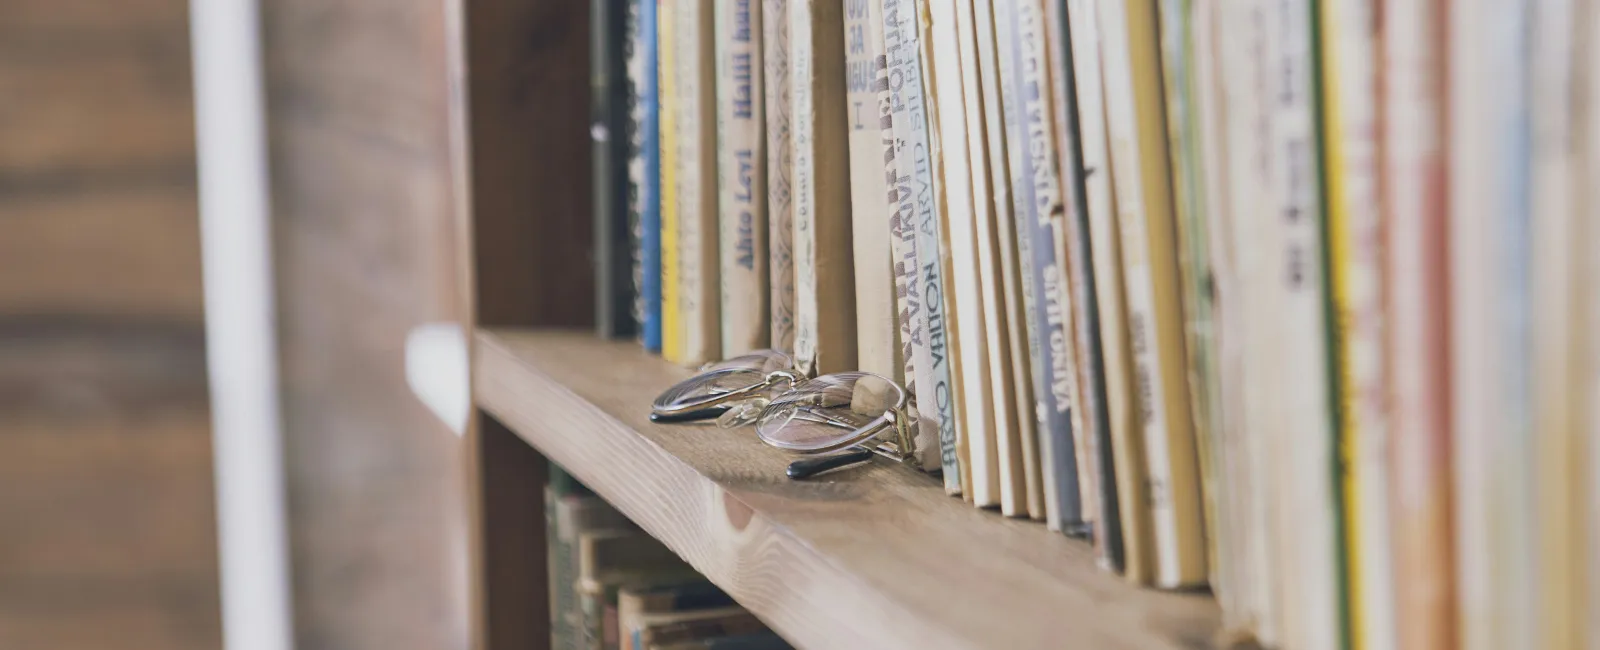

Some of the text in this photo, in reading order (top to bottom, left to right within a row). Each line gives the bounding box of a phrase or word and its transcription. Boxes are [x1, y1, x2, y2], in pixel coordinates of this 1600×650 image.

[733, 53, 753, 119] Halli
[914, 142, 933, 237] ARVID
[736, 211, 754, 271] Ahto
[923, 262, 943, 370] VALTON
